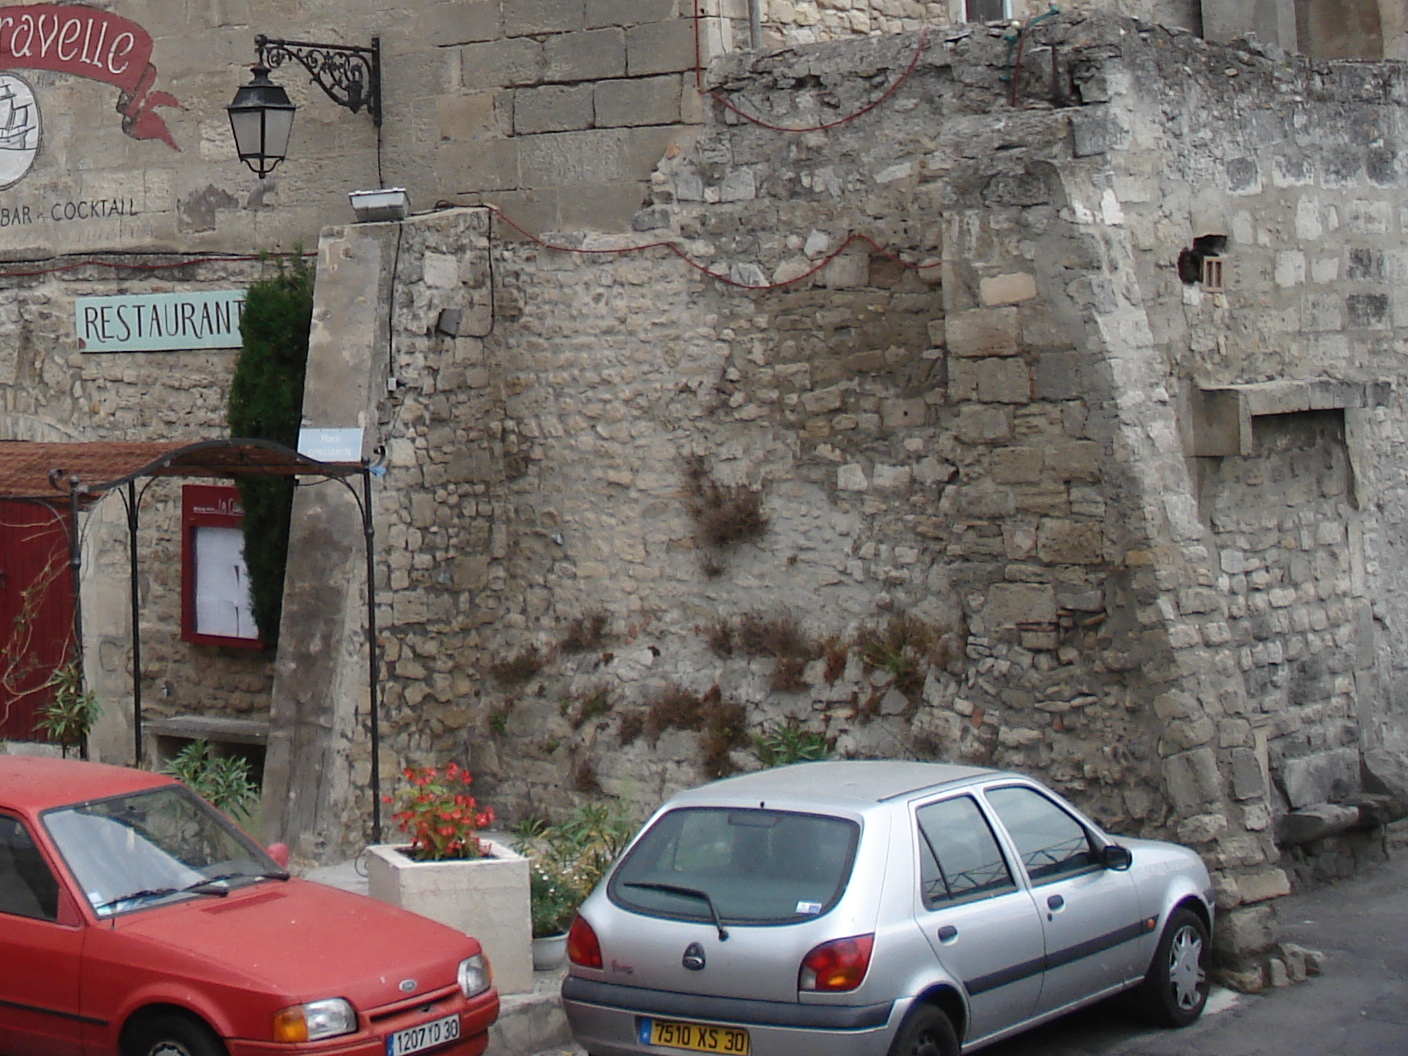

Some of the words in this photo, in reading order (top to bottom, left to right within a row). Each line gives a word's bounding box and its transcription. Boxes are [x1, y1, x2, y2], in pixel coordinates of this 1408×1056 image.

[0, 205, 33, 227] BAR
[50, 198, 140, 222] COCKTAIL
[84, 299, 245, 344] RESTAURANT
[397, 1028, 426, 1054] 1207
[428, 1023, 441, 1044] YD
[444, 1019, 459, 1040] 30
[655, 1023, 691, 1046] 7510
[697, 1027, 718, 1049] XS
[724, 1030, 745, 1052] 30
